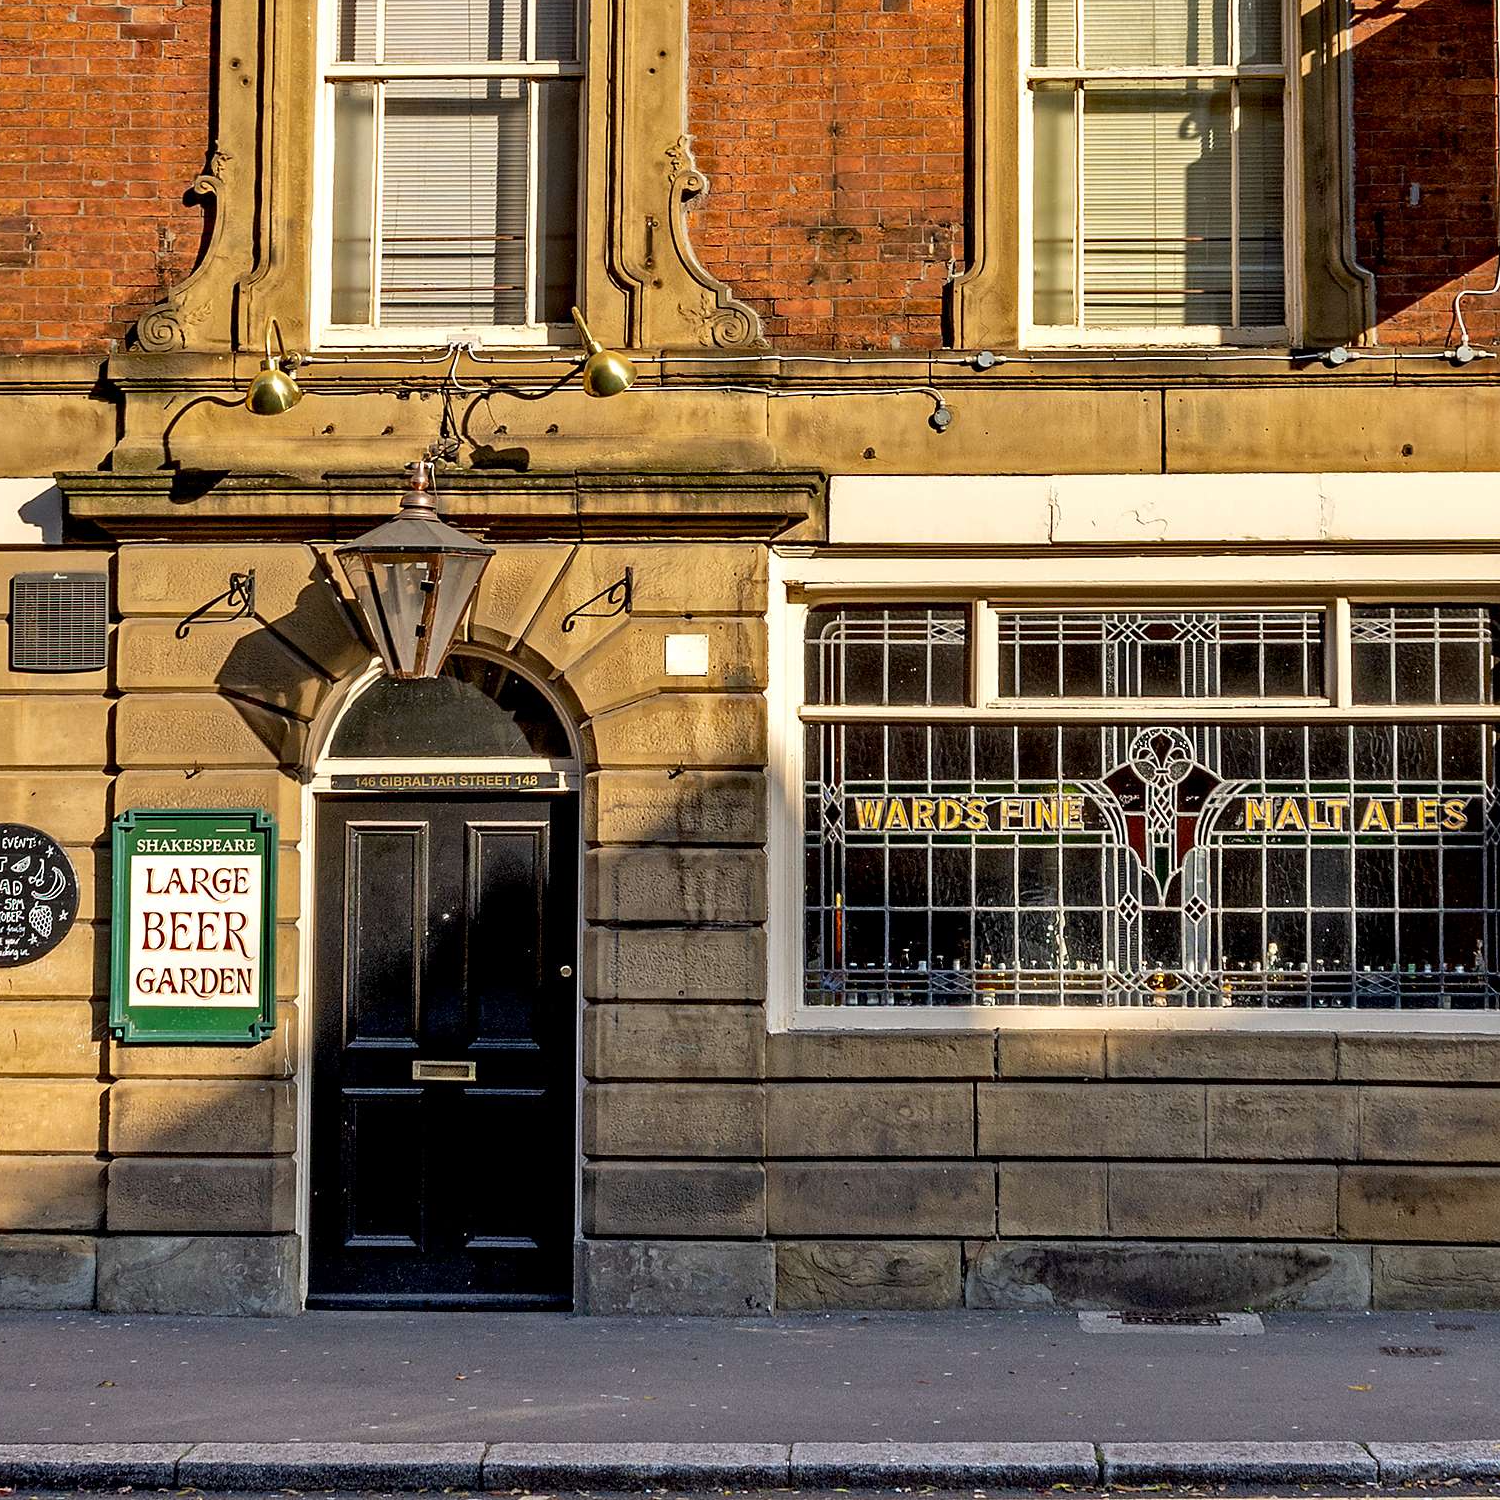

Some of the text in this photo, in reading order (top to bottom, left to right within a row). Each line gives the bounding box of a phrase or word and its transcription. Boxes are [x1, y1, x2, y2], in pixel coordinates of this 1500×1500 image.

[354, 774, 539, 788] 146 GIBRALTAR STREET 148
[1000, 798, 1084, 831] FINE
[1245, 798, 1348, 831] MALT
[1361, 799, 1467, 830] ALES
[136, 839, 257, 851] SHAKESPEARE
[146, 867, 252, 902] LARGE
[4, 898, 25, 910] 5PM
[141, 911, 255, 961] BEER
[135, 967, 253, 1000] GARDEN
